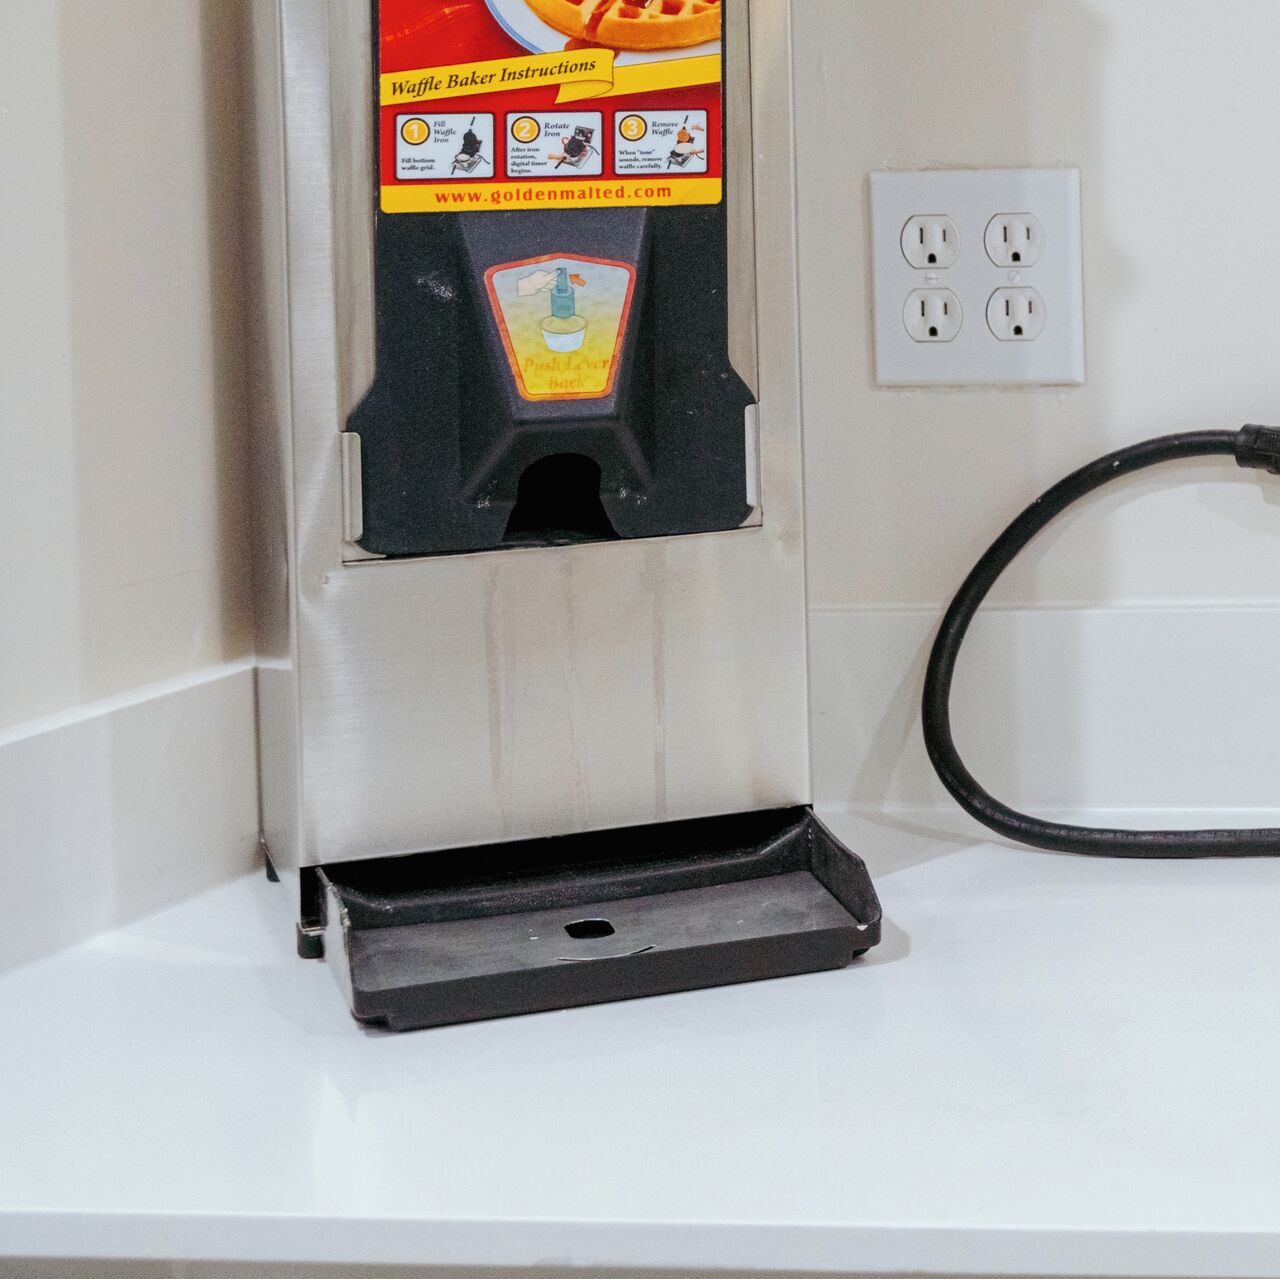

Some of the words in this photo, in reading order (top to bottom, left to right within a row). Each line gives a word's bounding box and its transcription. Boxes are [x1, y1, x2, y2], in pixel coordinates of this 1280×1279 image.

[391, 76, 442, 98] Waffle
[446, 70, 496, 89] Baker
[500, 60, 596, 82] Instructions
[409, 124, 419, 139] 1
[433, 128, 457, 137] Waffle
[518, 121, 531, 138] 2
[544, 122, 570, 130] Rotate
[626, 119, 638, 136] 3
[651, 128, 674, 137] Waffle
[435, 185, 673, 205] www.goldenmalted.com
[524, 358, 560, 372] Push
[565, 357, 609, 370] Lever
[548, 375, 585, 389] Back
